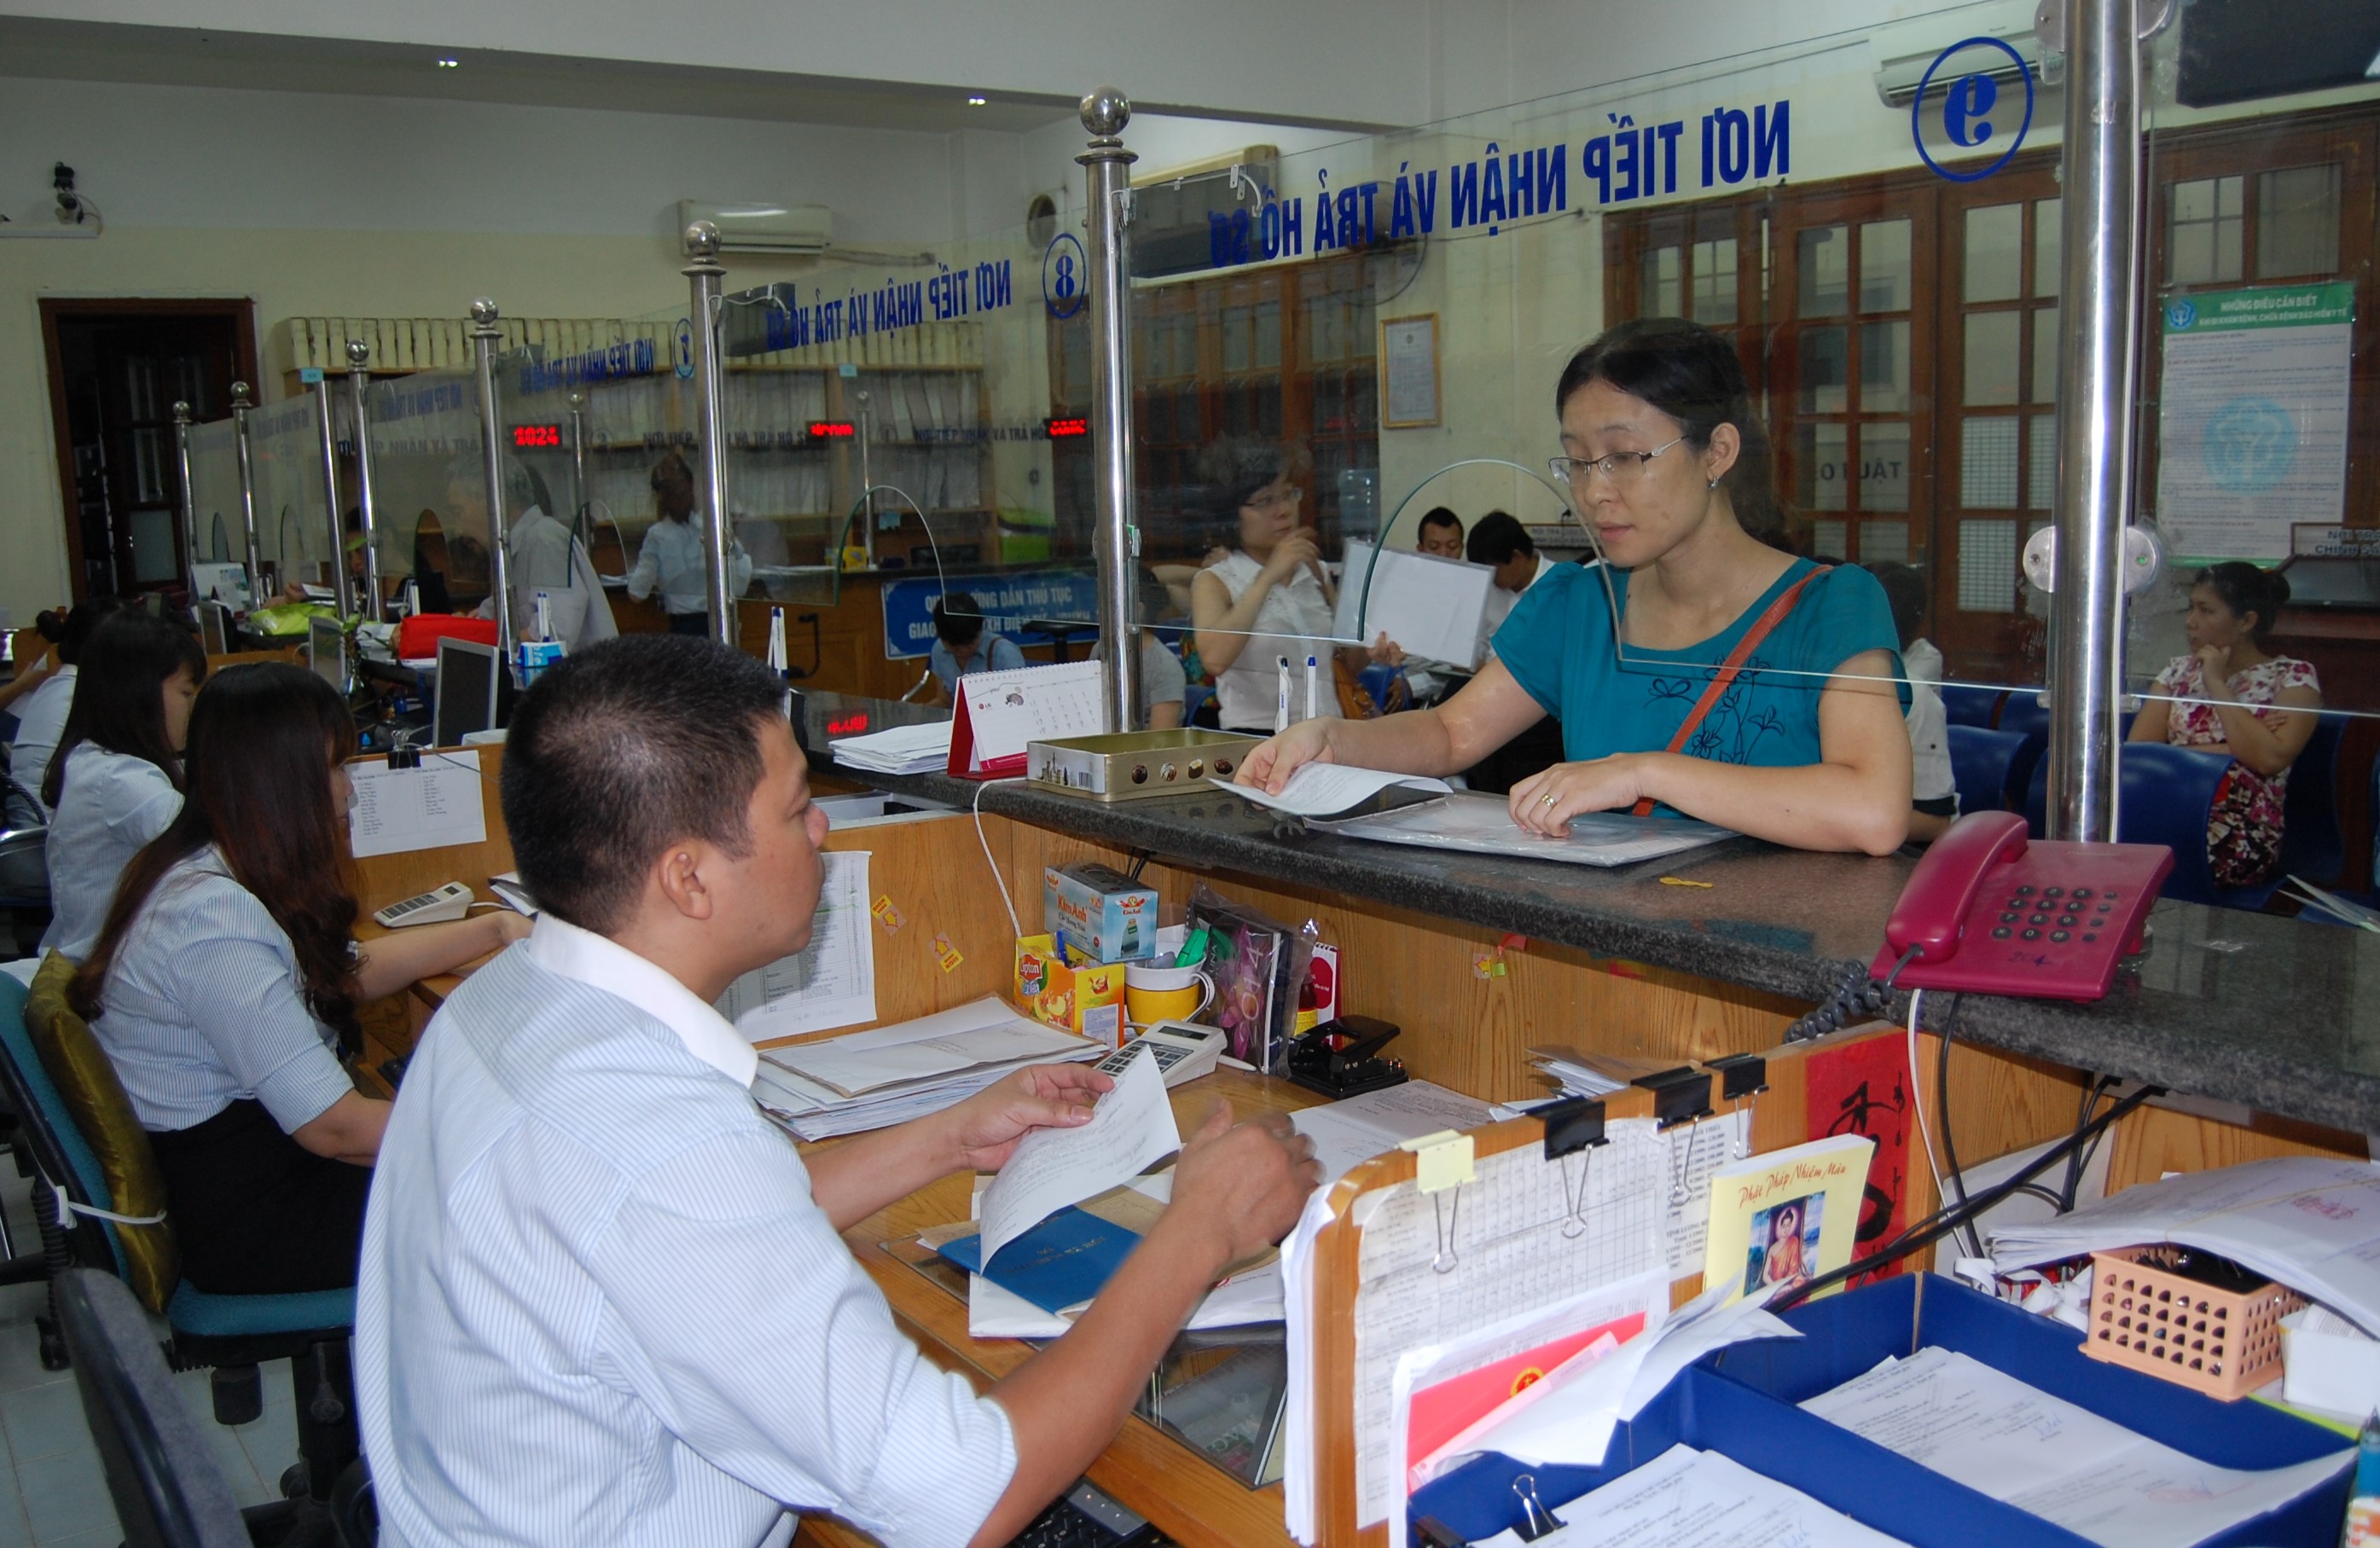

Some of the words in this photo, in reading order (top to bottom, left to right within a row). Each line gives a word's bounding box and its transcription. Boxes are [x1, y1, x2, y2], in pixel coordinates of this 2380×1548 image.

[1058, 893, 1072, 915] Kim
[1072, 903, 1087, 923] Anh
[1739, 1185, 1762, 1209] Phật
[1766, 1170, 1791, 1197] Pháp
[1791, 1162, 1822, 1186] Nhiệm
